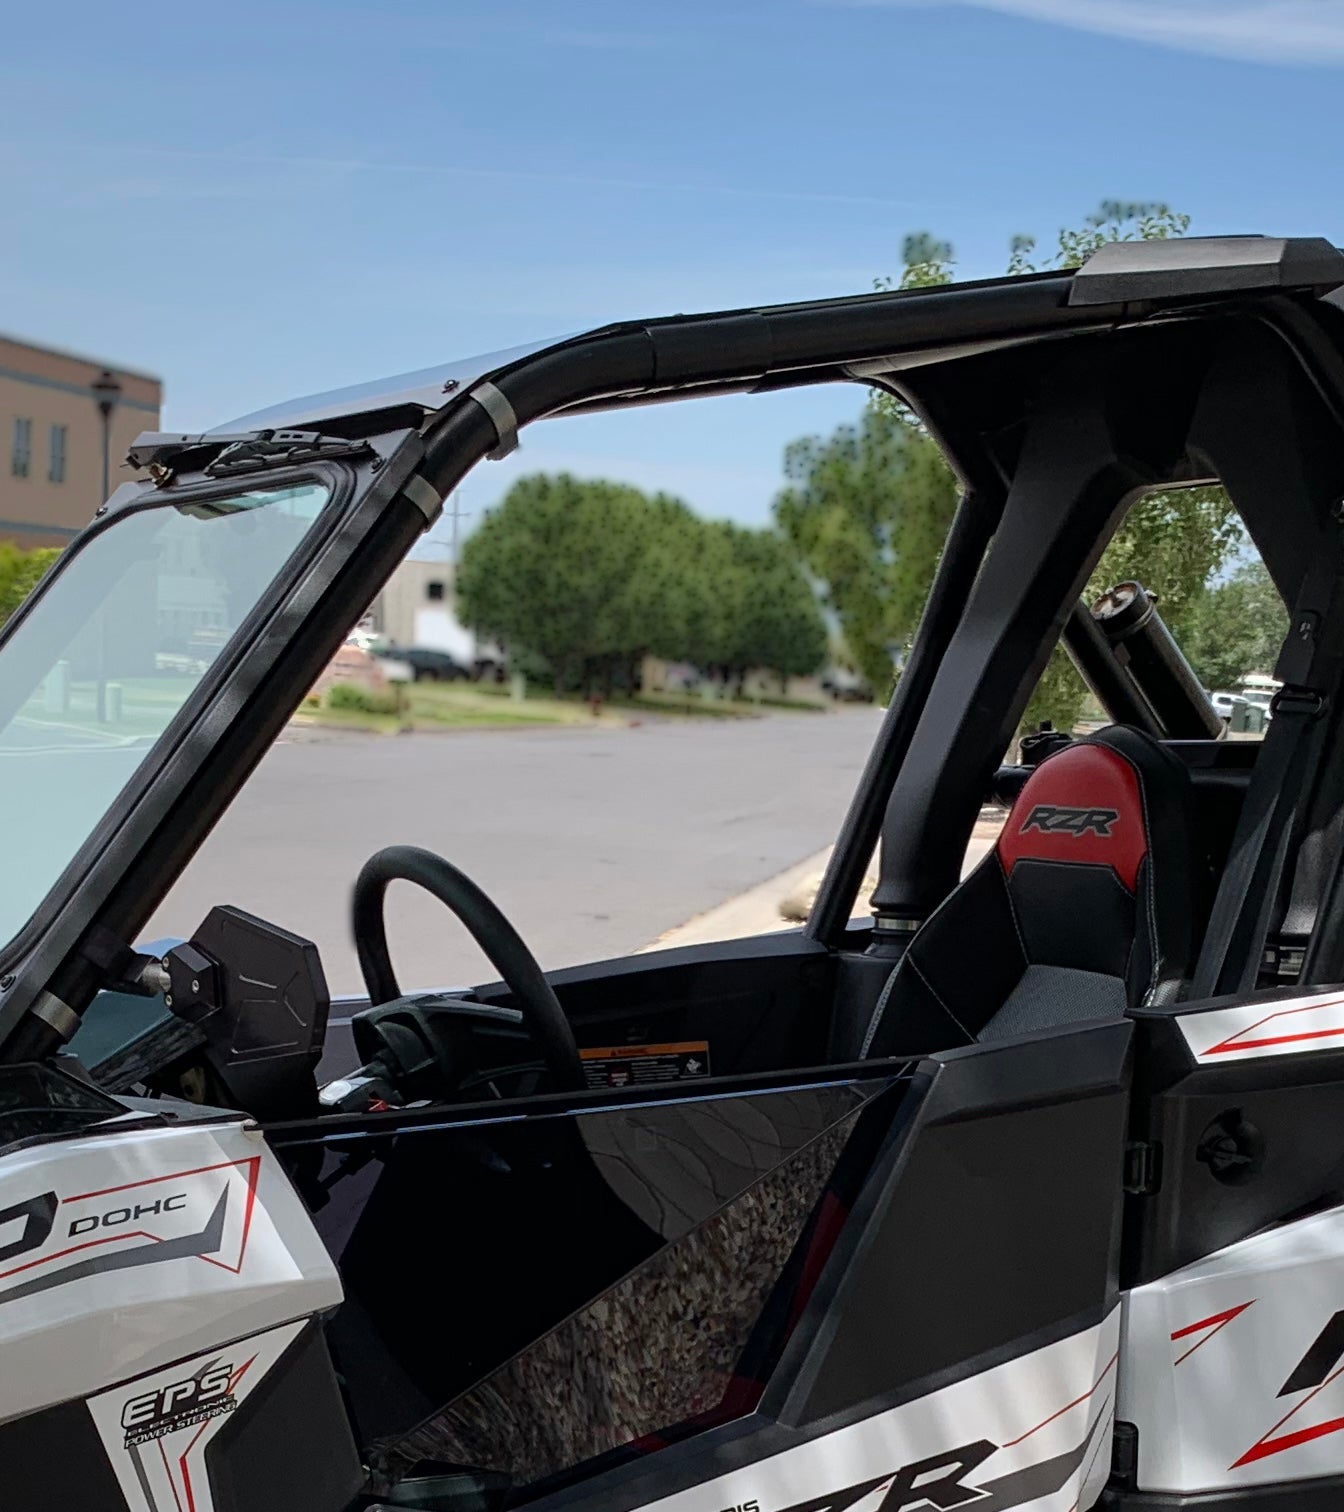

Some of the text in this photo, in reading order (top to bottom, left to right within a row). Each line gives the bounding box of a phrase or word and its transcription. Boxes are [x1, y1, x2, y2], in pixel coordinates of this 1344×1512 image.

[1019, 804, 1120, 837] RZR
[68, 1193, 187, 1238] DOHC
[121, 1363, 233, 1430] EPS
[124, 1401, 237, 1449] POWER STEERING
